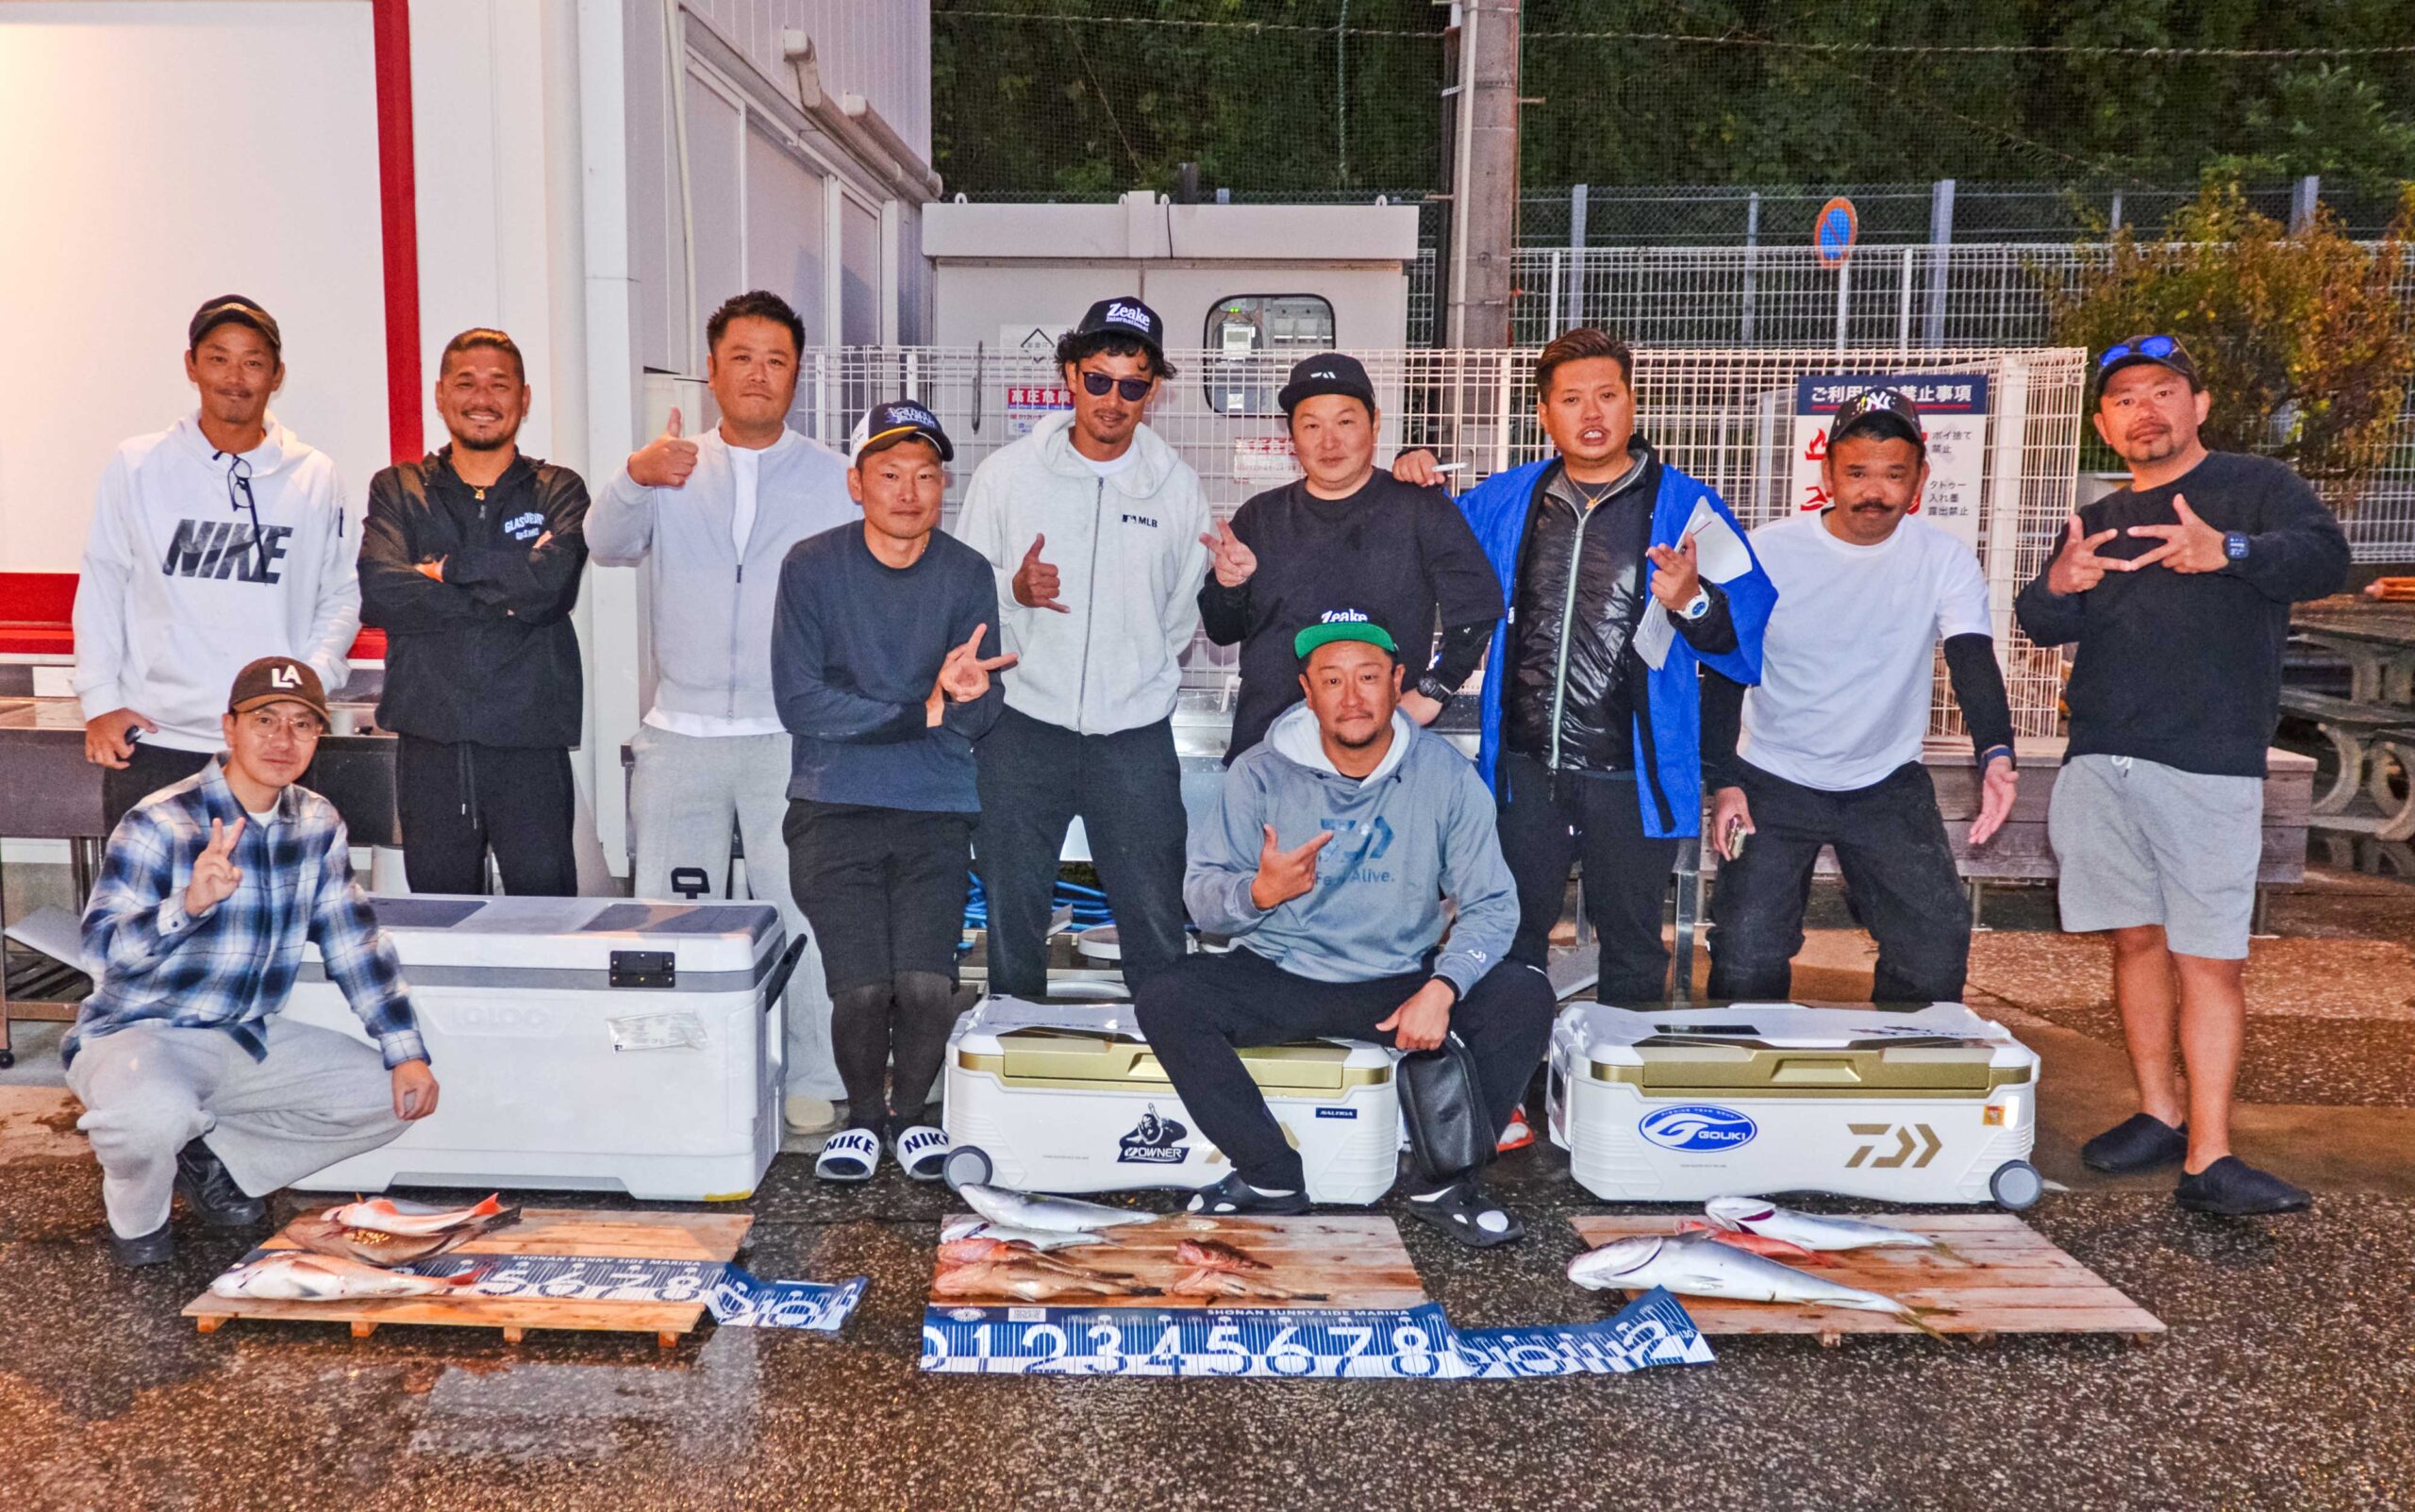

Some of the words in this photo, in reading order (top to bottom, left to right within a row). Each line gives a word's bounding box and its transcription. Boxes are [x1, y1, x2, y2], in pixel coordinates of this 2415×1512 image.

[1106, 303, 1151, 326] Zeake
[1864, 390, 1892, 412] NY
[1931, 444, 1952, 454] 禁止
[1929, 480, 1967, 490] タトゥー
[1928, 492, 1959, 503] 入れ墨
[1927, 506, 1970, 516] 露出禁止
[1138, 516, 1158, 528] MLB
[162, 519, 293, 585] NIKE
[1321, 607, 1368, 623] Zeake
[272, 664, 304, 689] LA
[1350, 869, 1395, 883] Alive.
[1698, 1130, 1746, 1140] GOUKI
[824, 1135, 875, 1156] NIKE
[1138, 1147, 1182, 1158] OWNER
[569, 1255, 614, 1264] SUNNY
[649, 1259, 702, 1268] MARINA
[478, 1270, 528, 1296] 5
[538, 1271, 588, 1298] 6
[596, 1273, 653, 1300] 7
[654, 1276, 703, 1302] 8
[973, 1323, 991, 1373] 1
[1022, 1323, 1068, 1374] 2
[1085, 1324, 1128, 1375] 3
[1145, 1325, 1187, 1375] 4
[1207, 1325, 1254, 1376] 5
[1266, 1325, 1317, 1377] 6
[1326, 1326, 1373, 1377] 7
[1391, 1326, 1441, 1378] 8
[1489, 1344, 1568, 1377] 10
